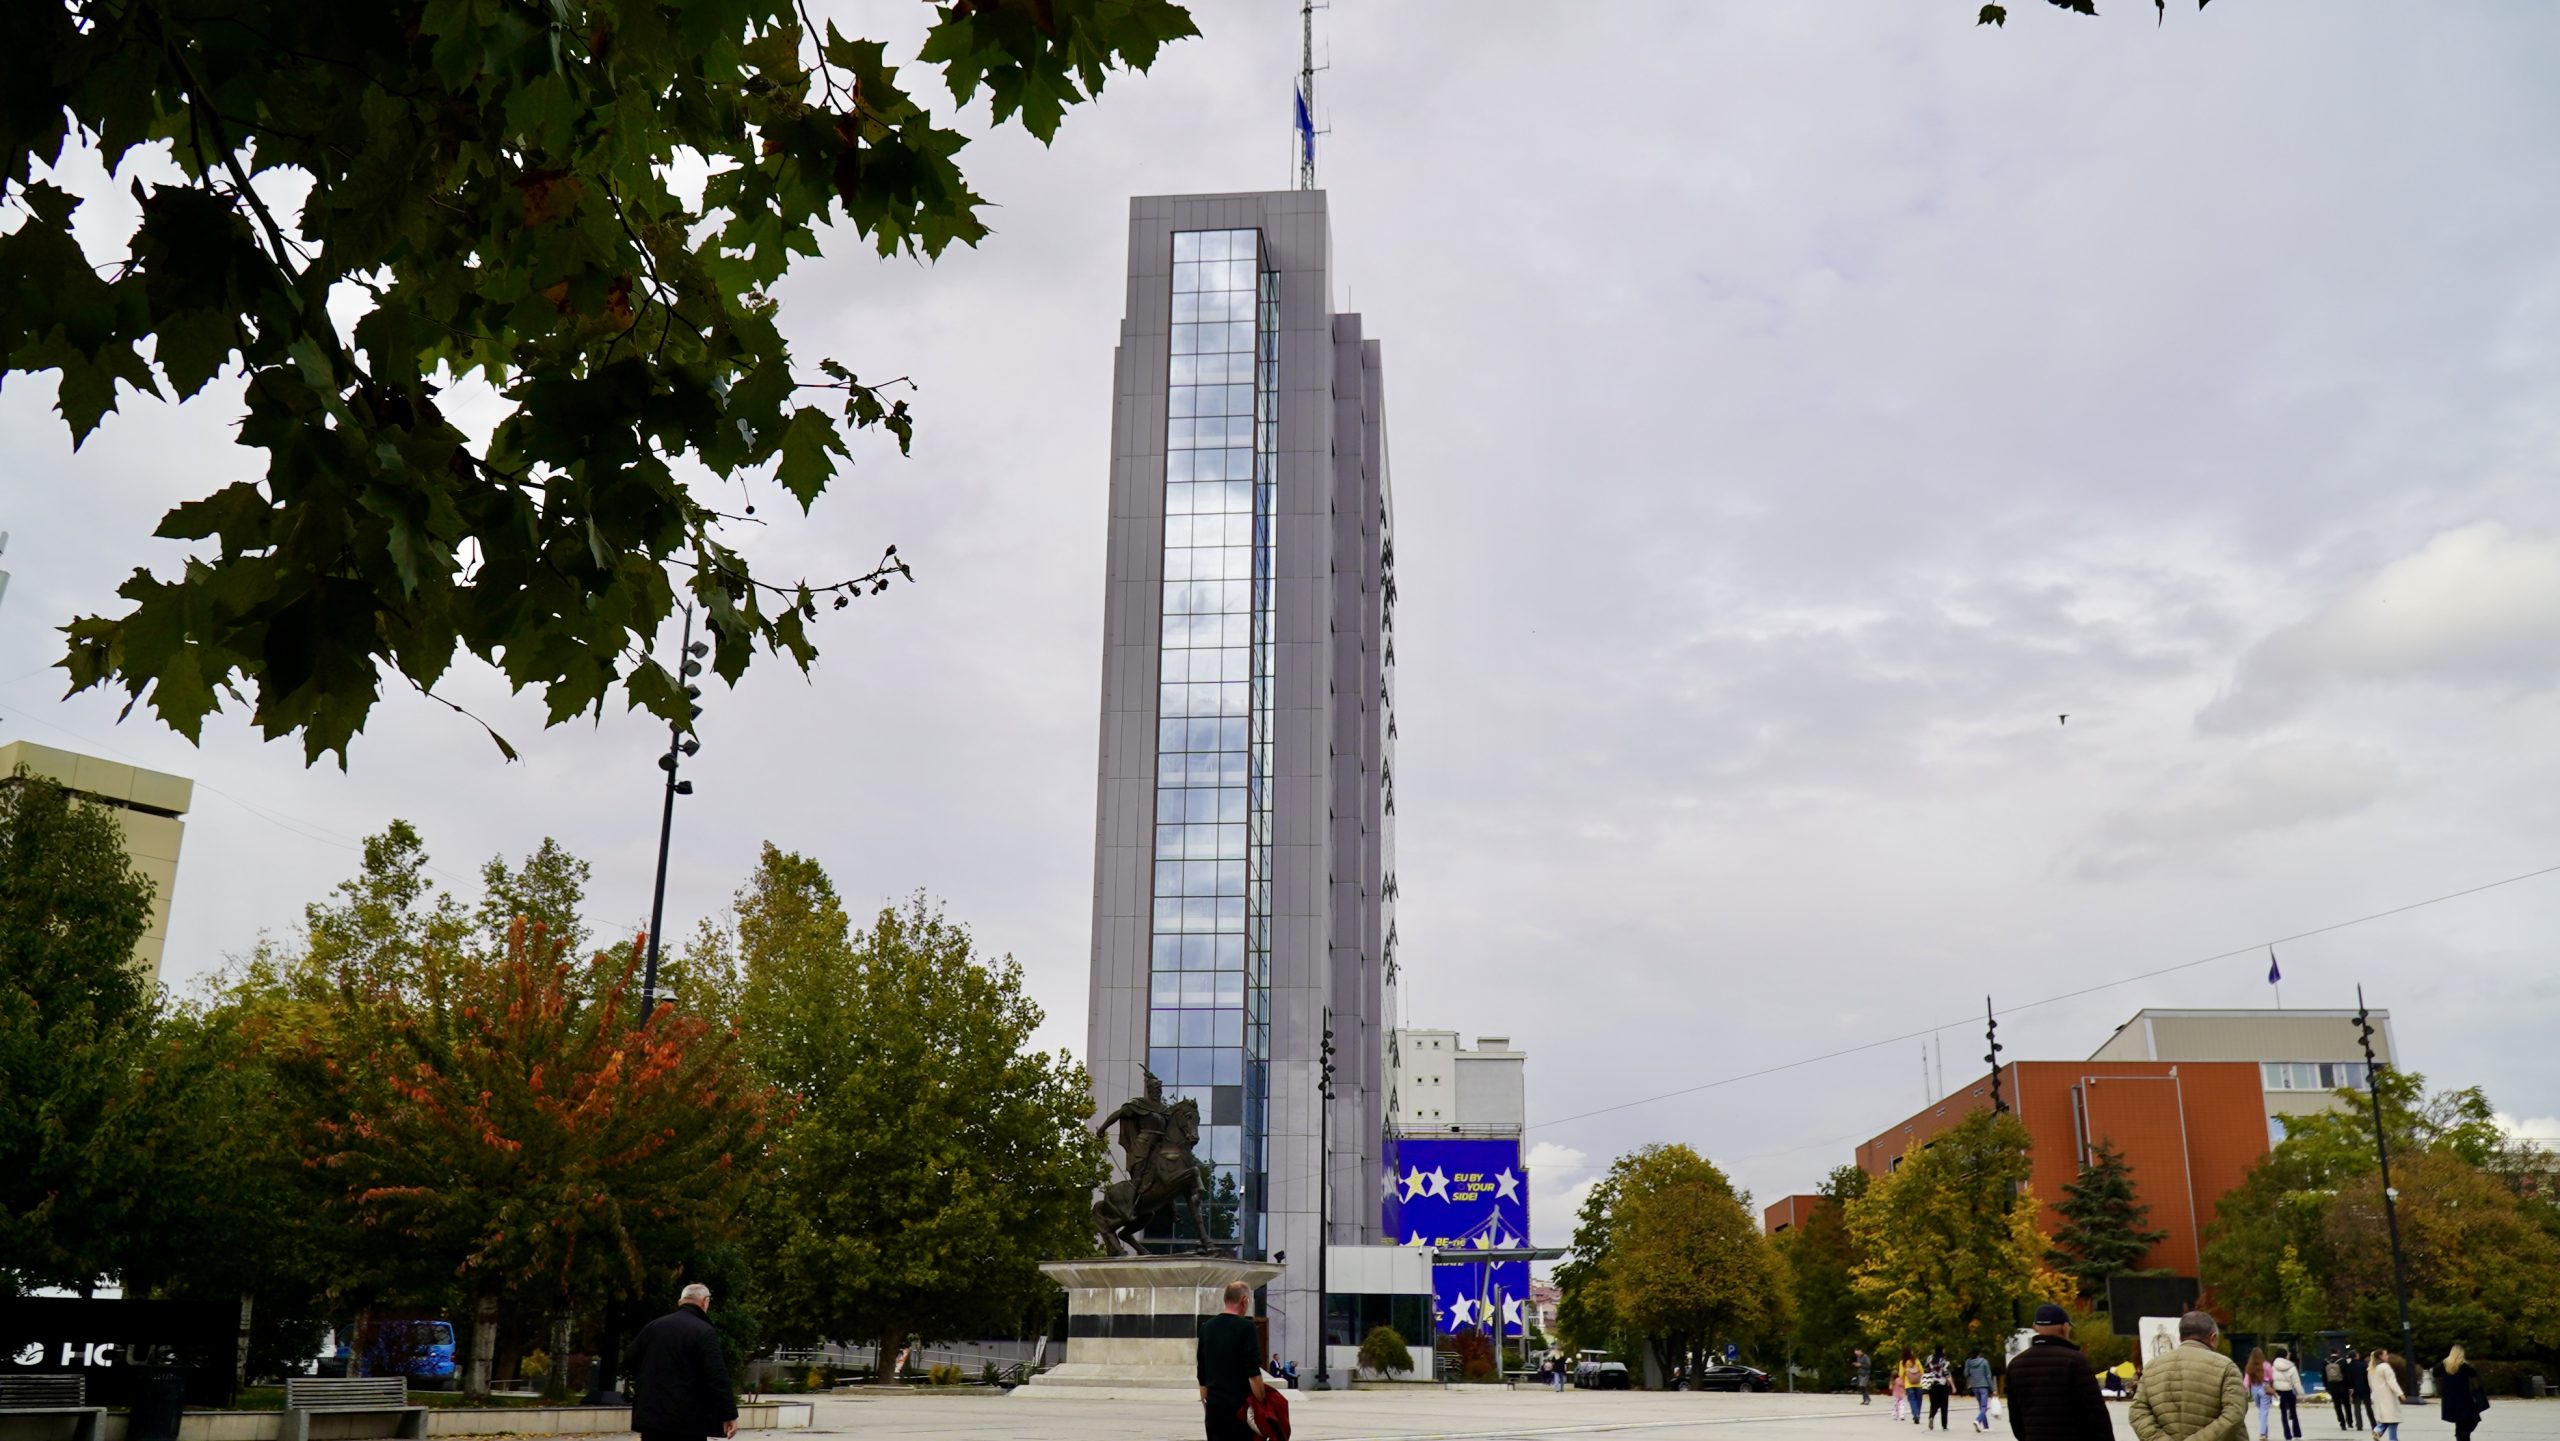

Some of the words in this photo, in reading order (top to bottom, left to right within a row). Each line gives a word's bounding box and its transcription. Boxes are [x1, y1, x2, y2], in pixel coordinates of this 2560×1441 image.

[1454, 1173, 1469, 1182] EU
[1469, 1173, 1484, 1182] BY
[1466, 1182, 1495, 1191] YOUR
[1452, 1192, 1478, 1201] SIDE!
[1728, 1345, 1735, 1355] P
